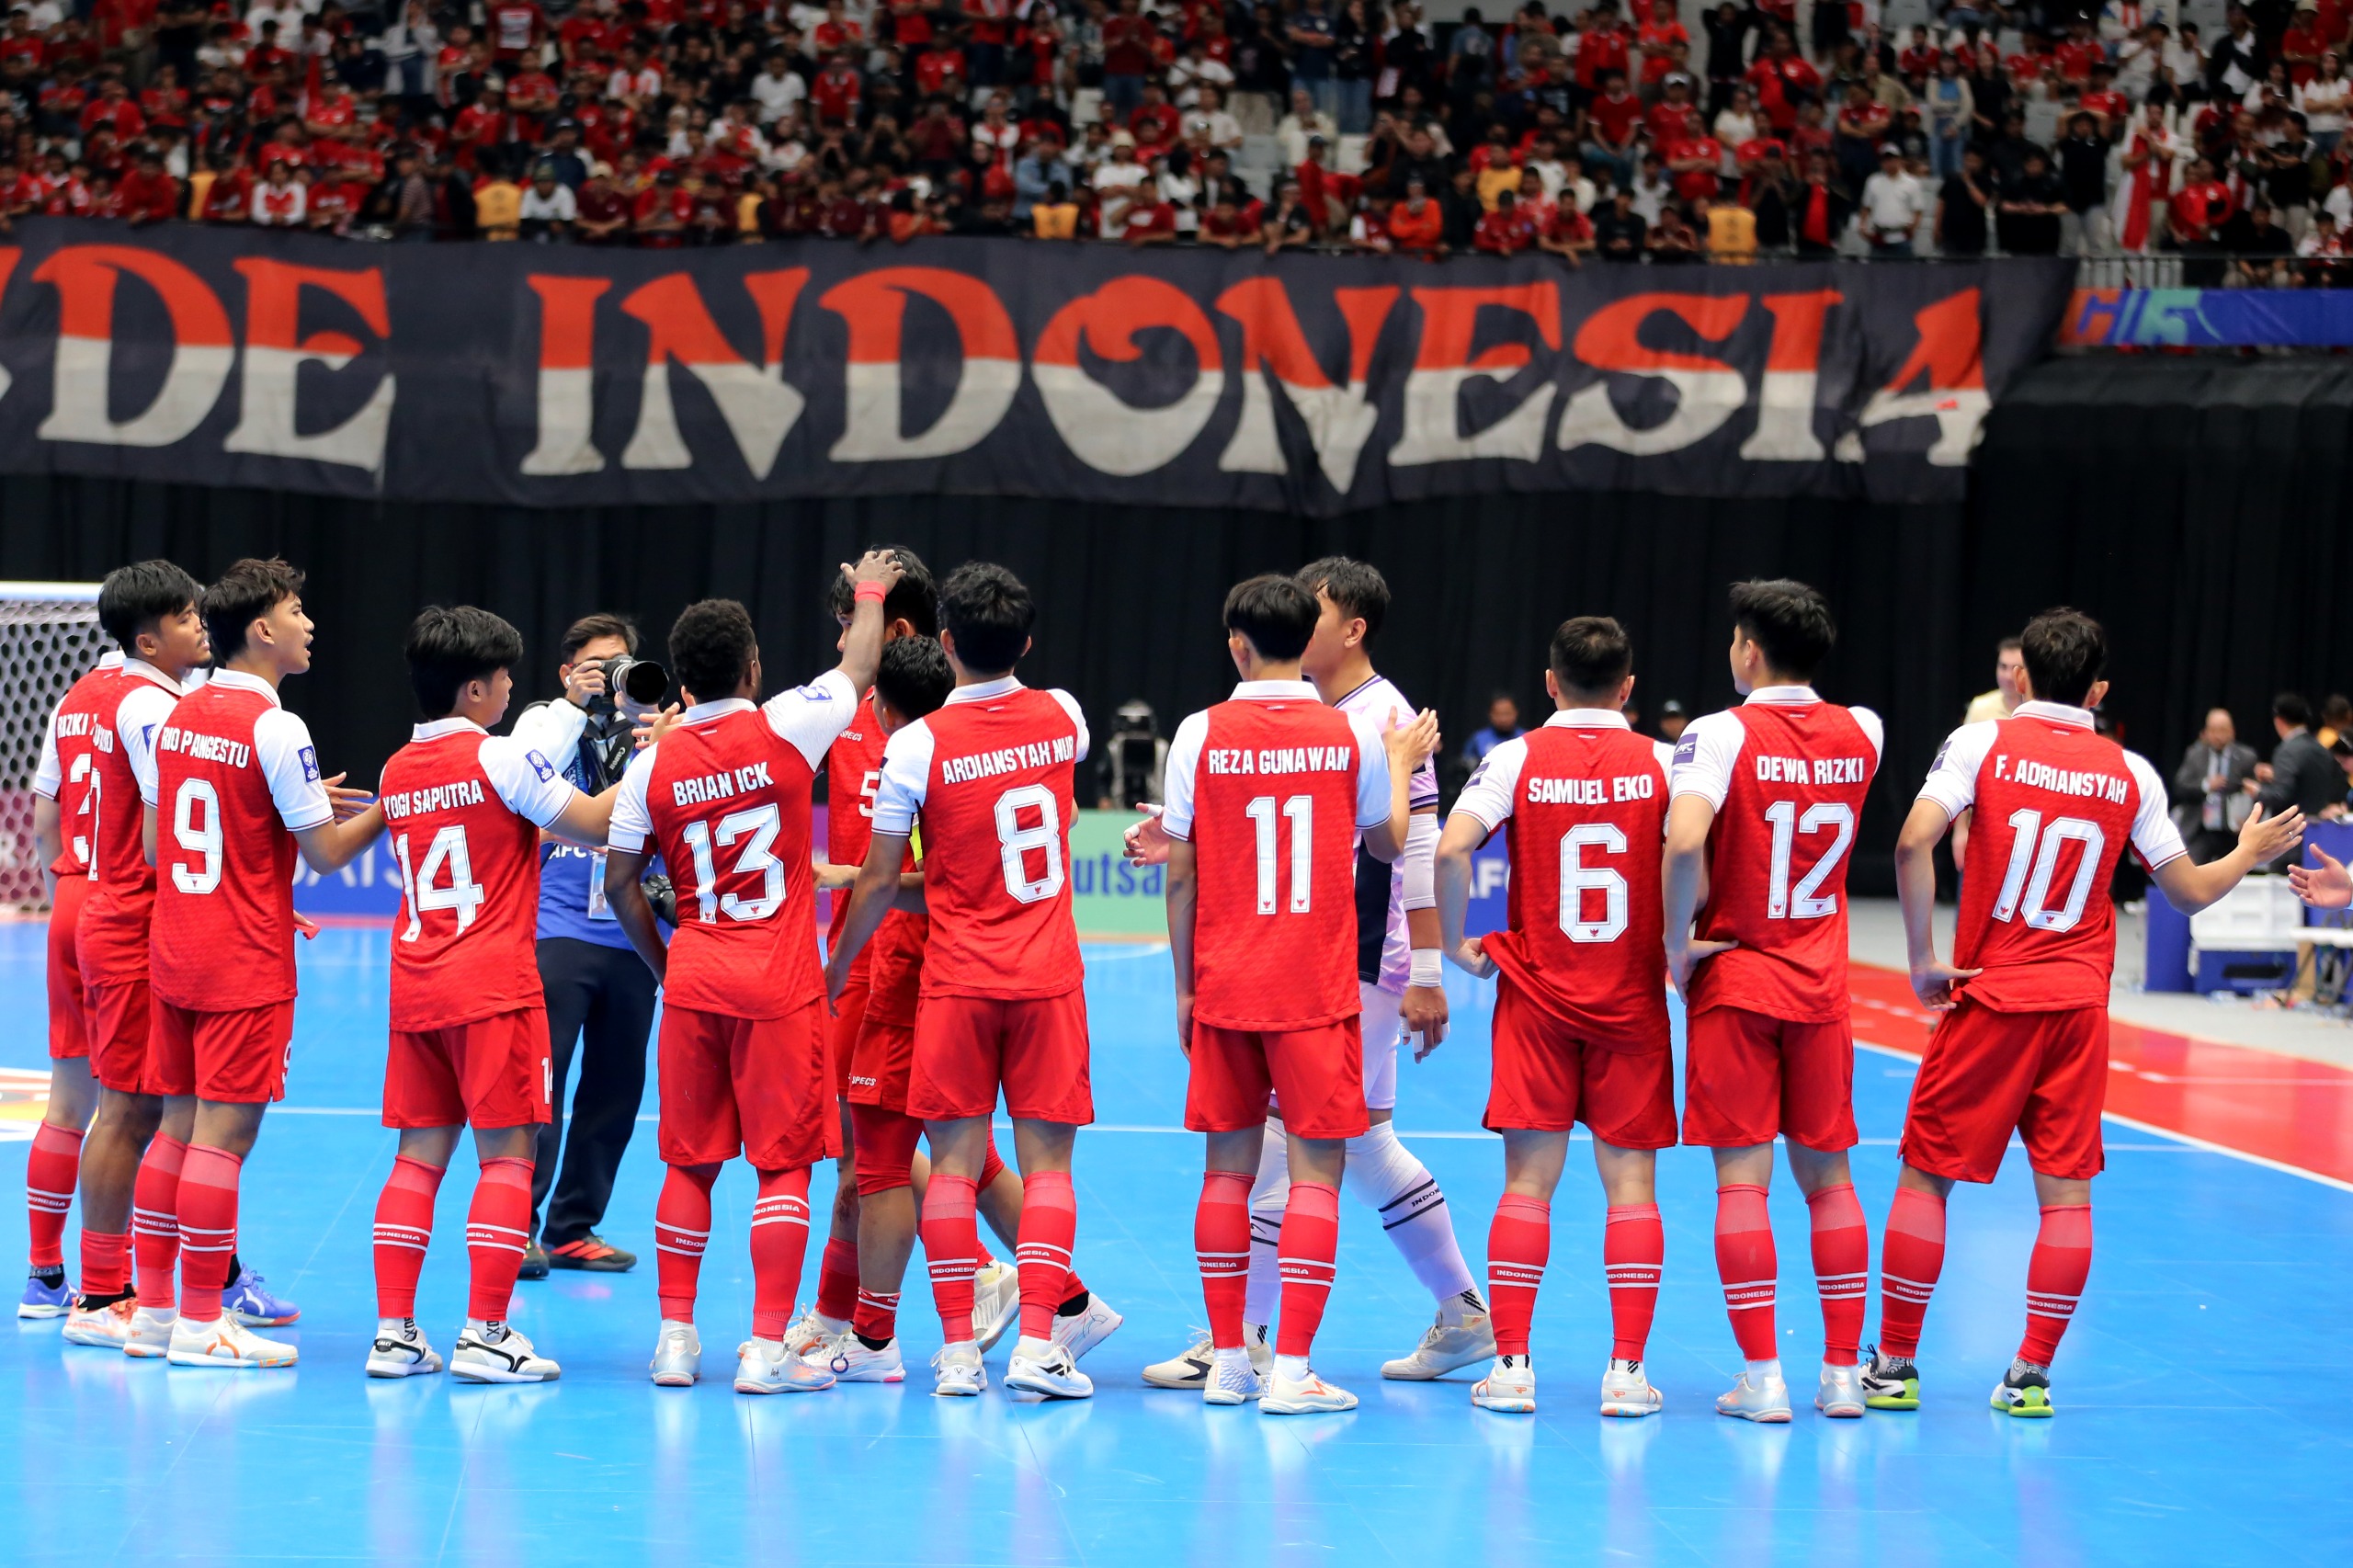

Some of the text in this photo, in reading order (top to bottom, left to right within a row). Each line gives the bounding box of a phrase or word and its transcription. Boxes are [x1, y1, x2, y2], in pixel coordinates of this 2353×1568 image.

[521, 265, 1992, 495] INDONESIA
[58, 712, 89, 739] RIZKI
[160, 726, 251, 769] RIO PANGESTU
[941, 735, 1074, 785] ARDIANSYAH NUR
[1208, 746, 1350, 775] REZA GUNAWAN
[672, 761, 774, 807] BRIAN ICK
[1756, 755, 1864, 785] DEWA RIZKI
[1995, 754, 2128, 805] F. ADRIANSYAH
[382, 778, 485, 821] YOGI SAPUTRA
[858, 770, 880, 818] 5
[1528, 774, 1654, 806] SAMUEL EKO
[171, 777, 223, 894] 9
[994, 782, 1065, 904] 8
[682, 801, 787, 925] 13
[1245, 794, 1313, 915] 11
[1765, 800, 1854, 919] 12
[1991, 807, 2105, 934] 10
[395, 824, 484, 942] 14
[1074, 852, 1164, 895] utsa
[1559, 822, 1628, 943] 6
[541, 1057, 553, 1104] 1
[851, 1075, 877, 1086] SPECS
[28, 1195, 66, 1207] DONESIA
[754, 1204, 800, 1215] DONESIA
[1411, 1187, 1440, 1207] INDON
[132, 1216, 176, 1229] DONESIA
[373, 1231, 420, 1241] DONESIA
[676, 1236, 707, 1248] INDON
[1279, 1267, 1309, 1275] NESIA
[1496, 1269, 1540, 1280] INDONES
[1818, 1282, 1865, 1290] INDONESIA
[1726, 1290, 1774, 1301] INDONESIA
[1896, 1285, 1931, 1296] INDONE
[2027, 1299, 2073, 1311] NDONESIA
